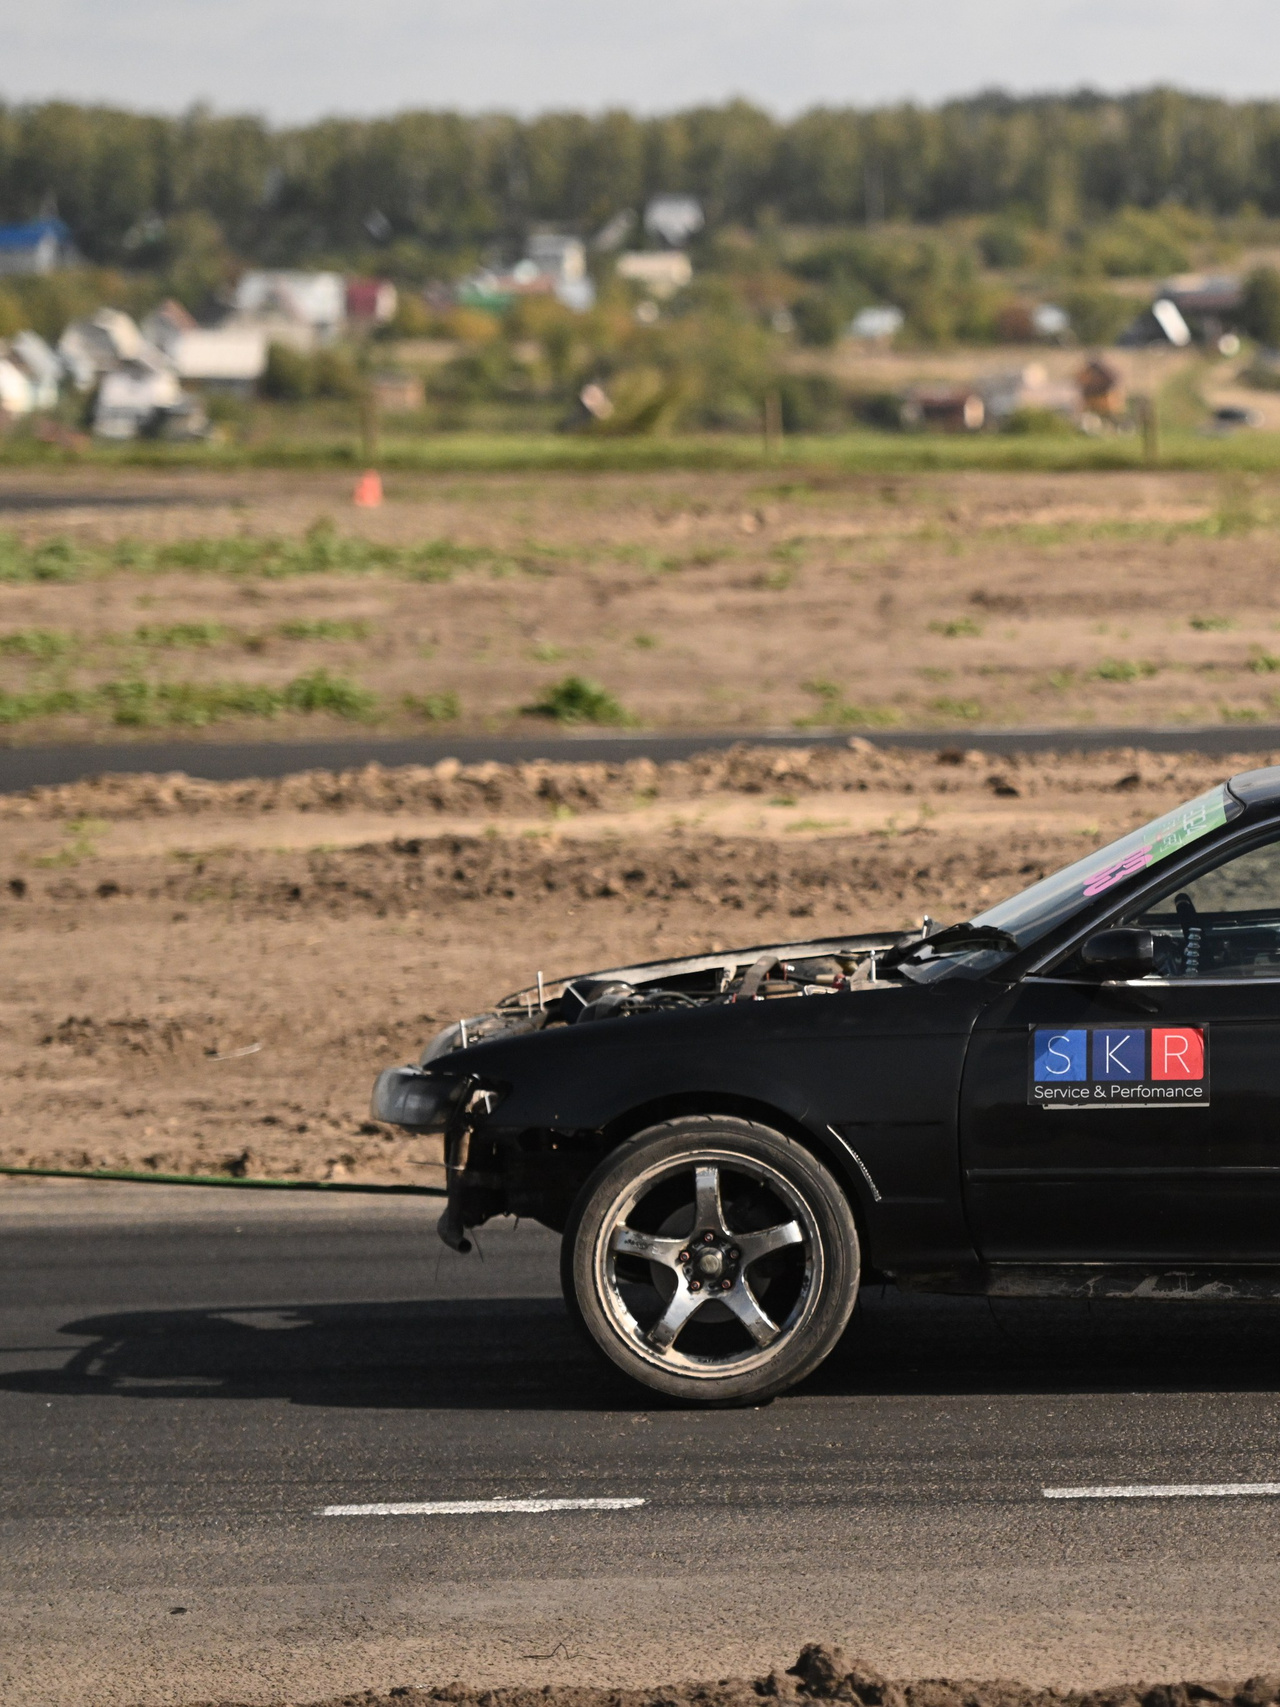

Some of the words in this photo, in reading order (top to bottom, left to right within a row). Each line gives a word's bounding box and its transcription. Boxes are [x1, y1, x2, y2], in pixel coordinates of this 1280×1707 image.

[1045, 1034, 1191, 1075] SKR
[1034, 1085, 1090, 1099] Service
[1093, 1085, 1107, 1098] &
[1111, 1084, 1203, 1098] Perfomance
